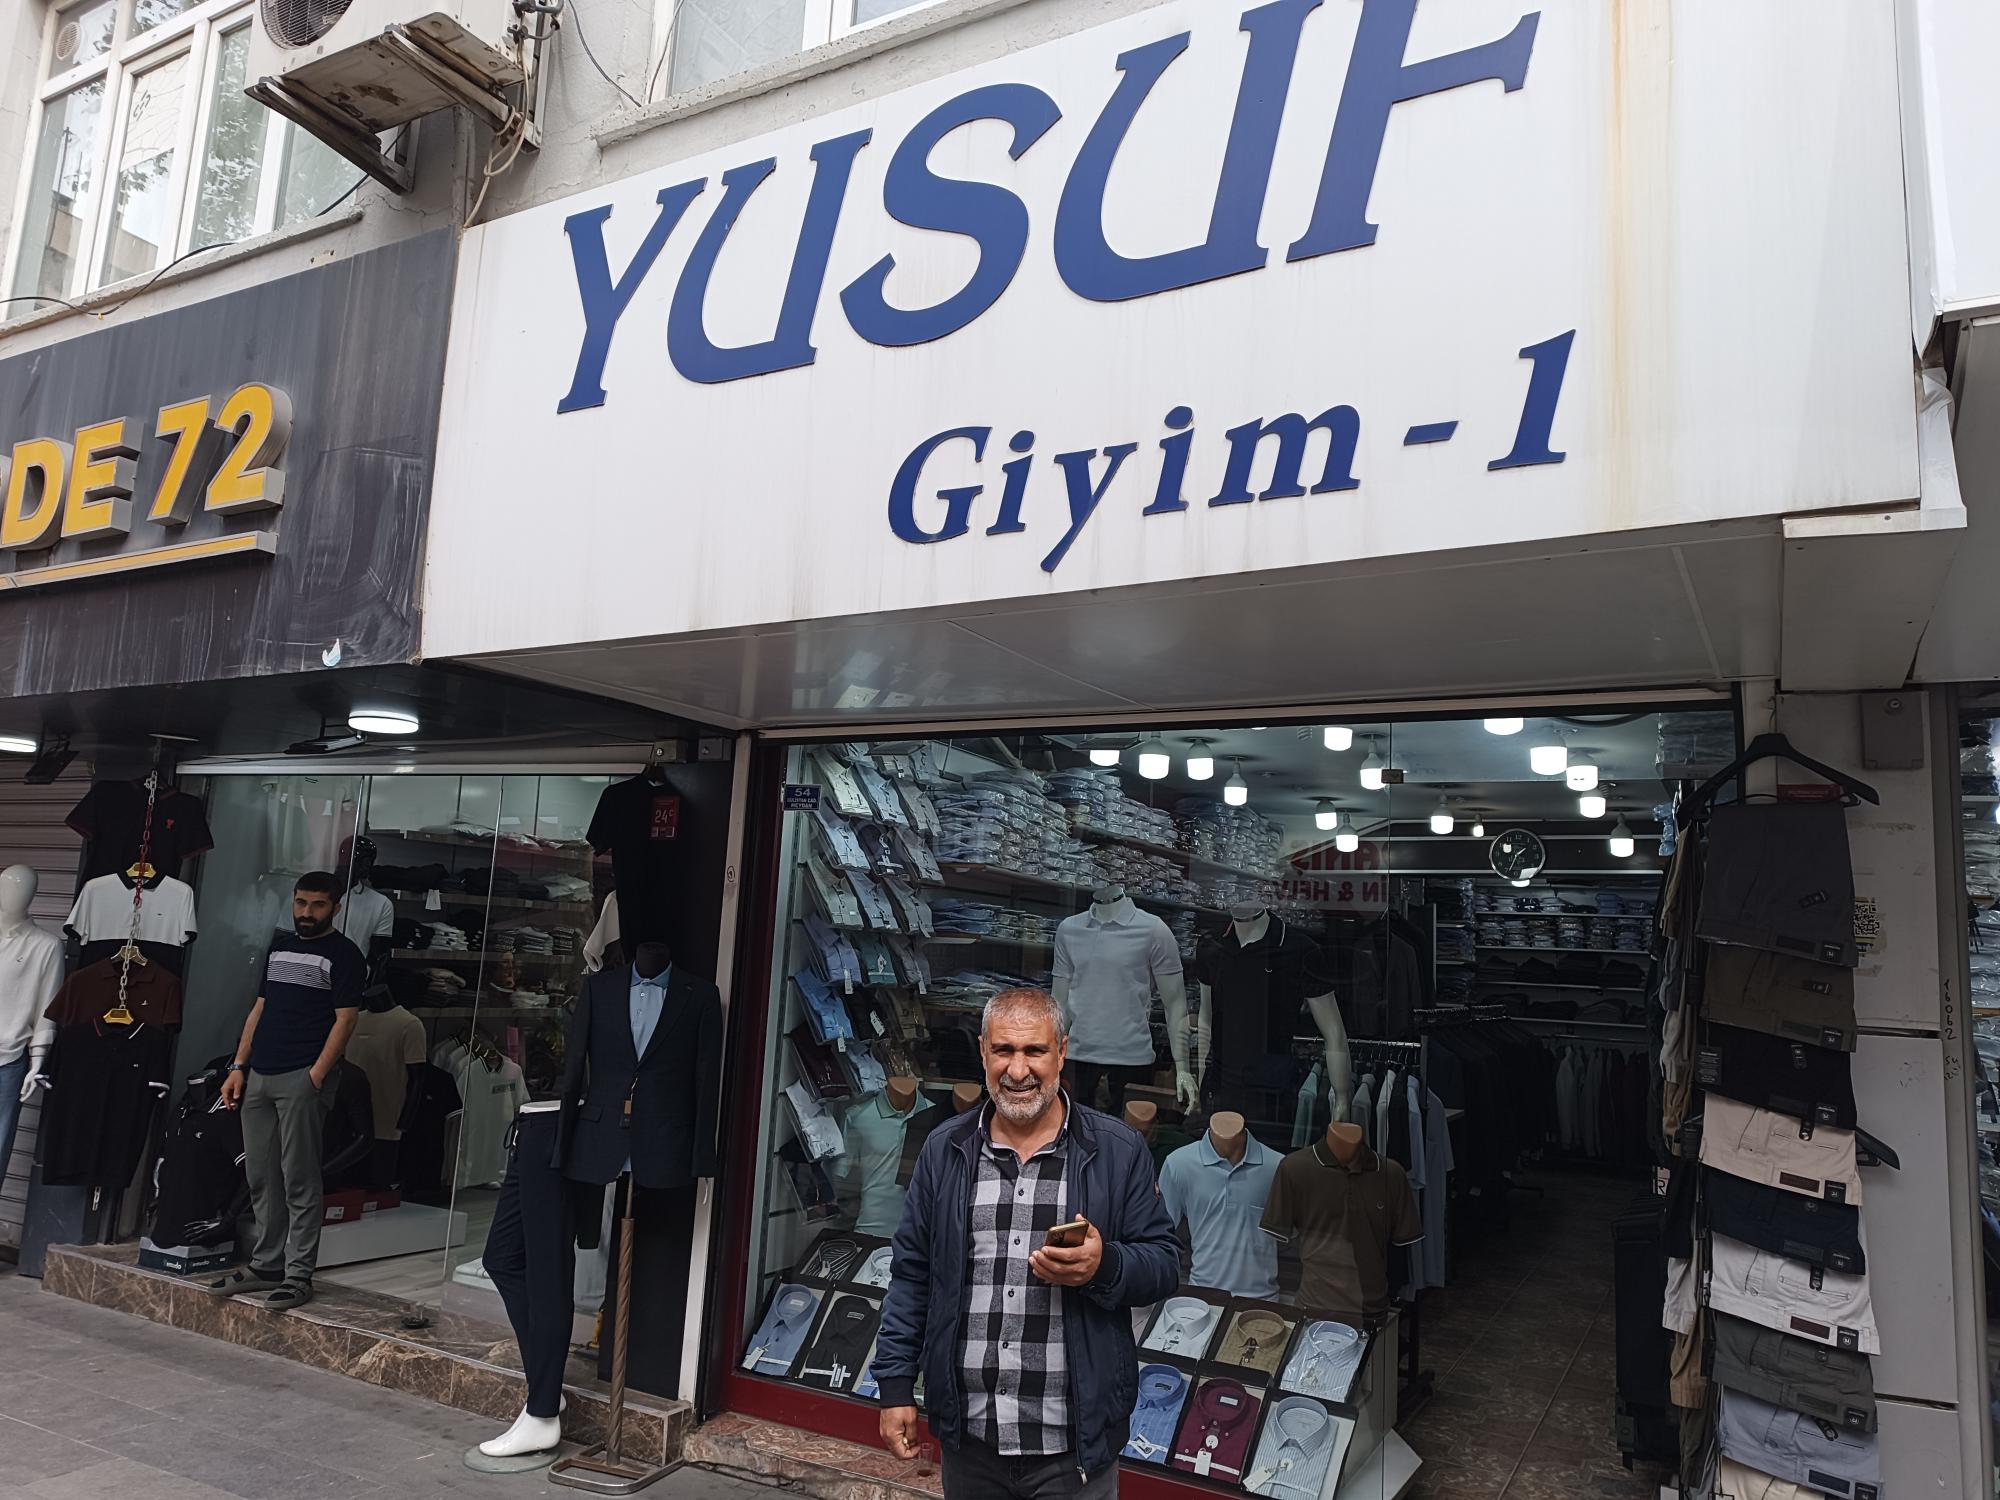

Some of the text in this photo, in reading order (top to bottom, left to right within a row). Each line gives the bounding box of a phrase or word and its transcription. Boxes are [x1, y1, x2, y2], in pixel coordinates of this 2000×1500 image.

[557, 0, 1540, 414] YUSUF
[147, 381, 288, 525] 72
[887, 403, 1361, 573] Giyim
[794, 787, 812, 797] 54
